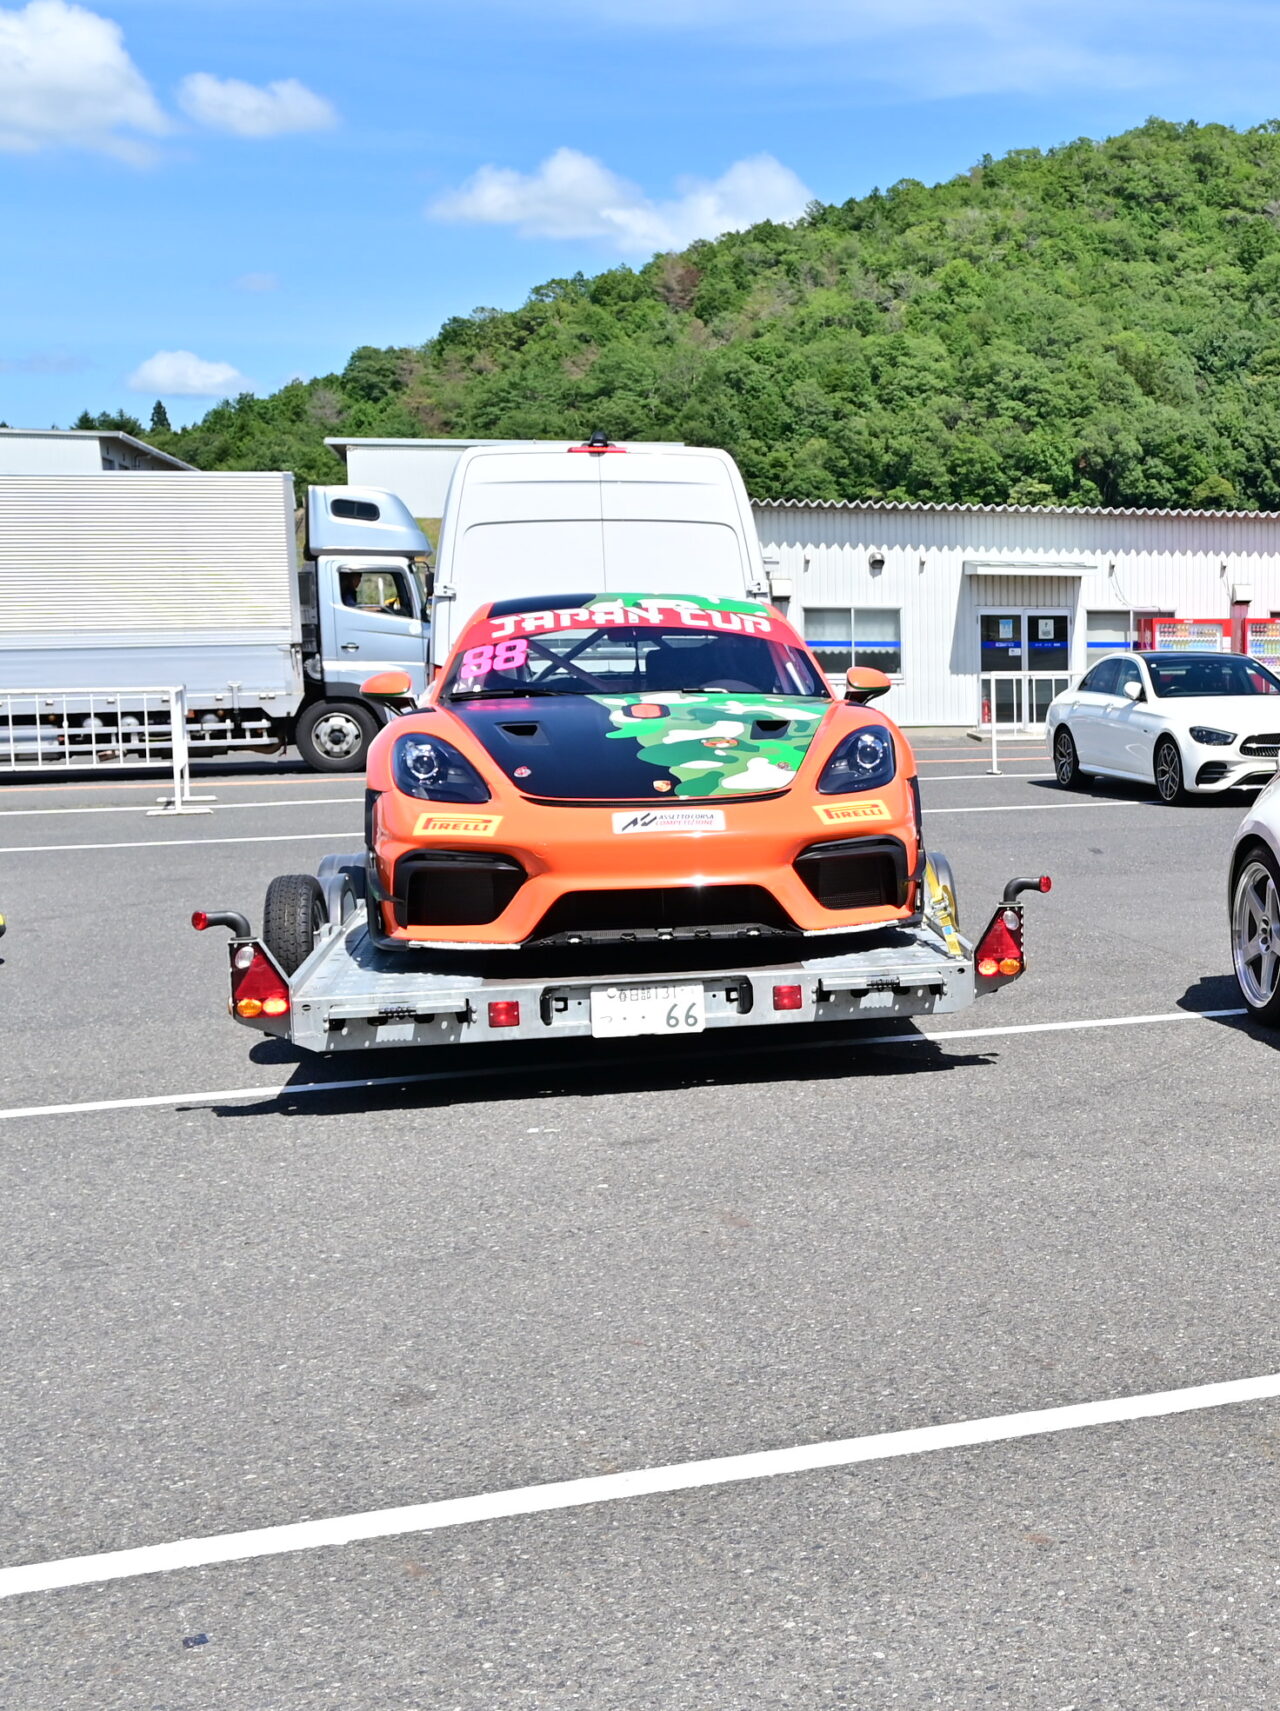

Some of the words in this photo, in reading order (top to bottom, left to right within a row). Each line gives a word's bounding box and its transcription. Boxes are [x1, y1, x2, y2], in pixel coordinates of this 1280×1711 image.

[490, 606, 663, 639] JAPAN
[679, 607, 772, 633] CUP
[461, 639, 529, 679] 88
[422, 817, 492, 831] PIRELLI
[822, 803, 884, 820] PIRELLI
[666, 1002, 698, 1028] 66
